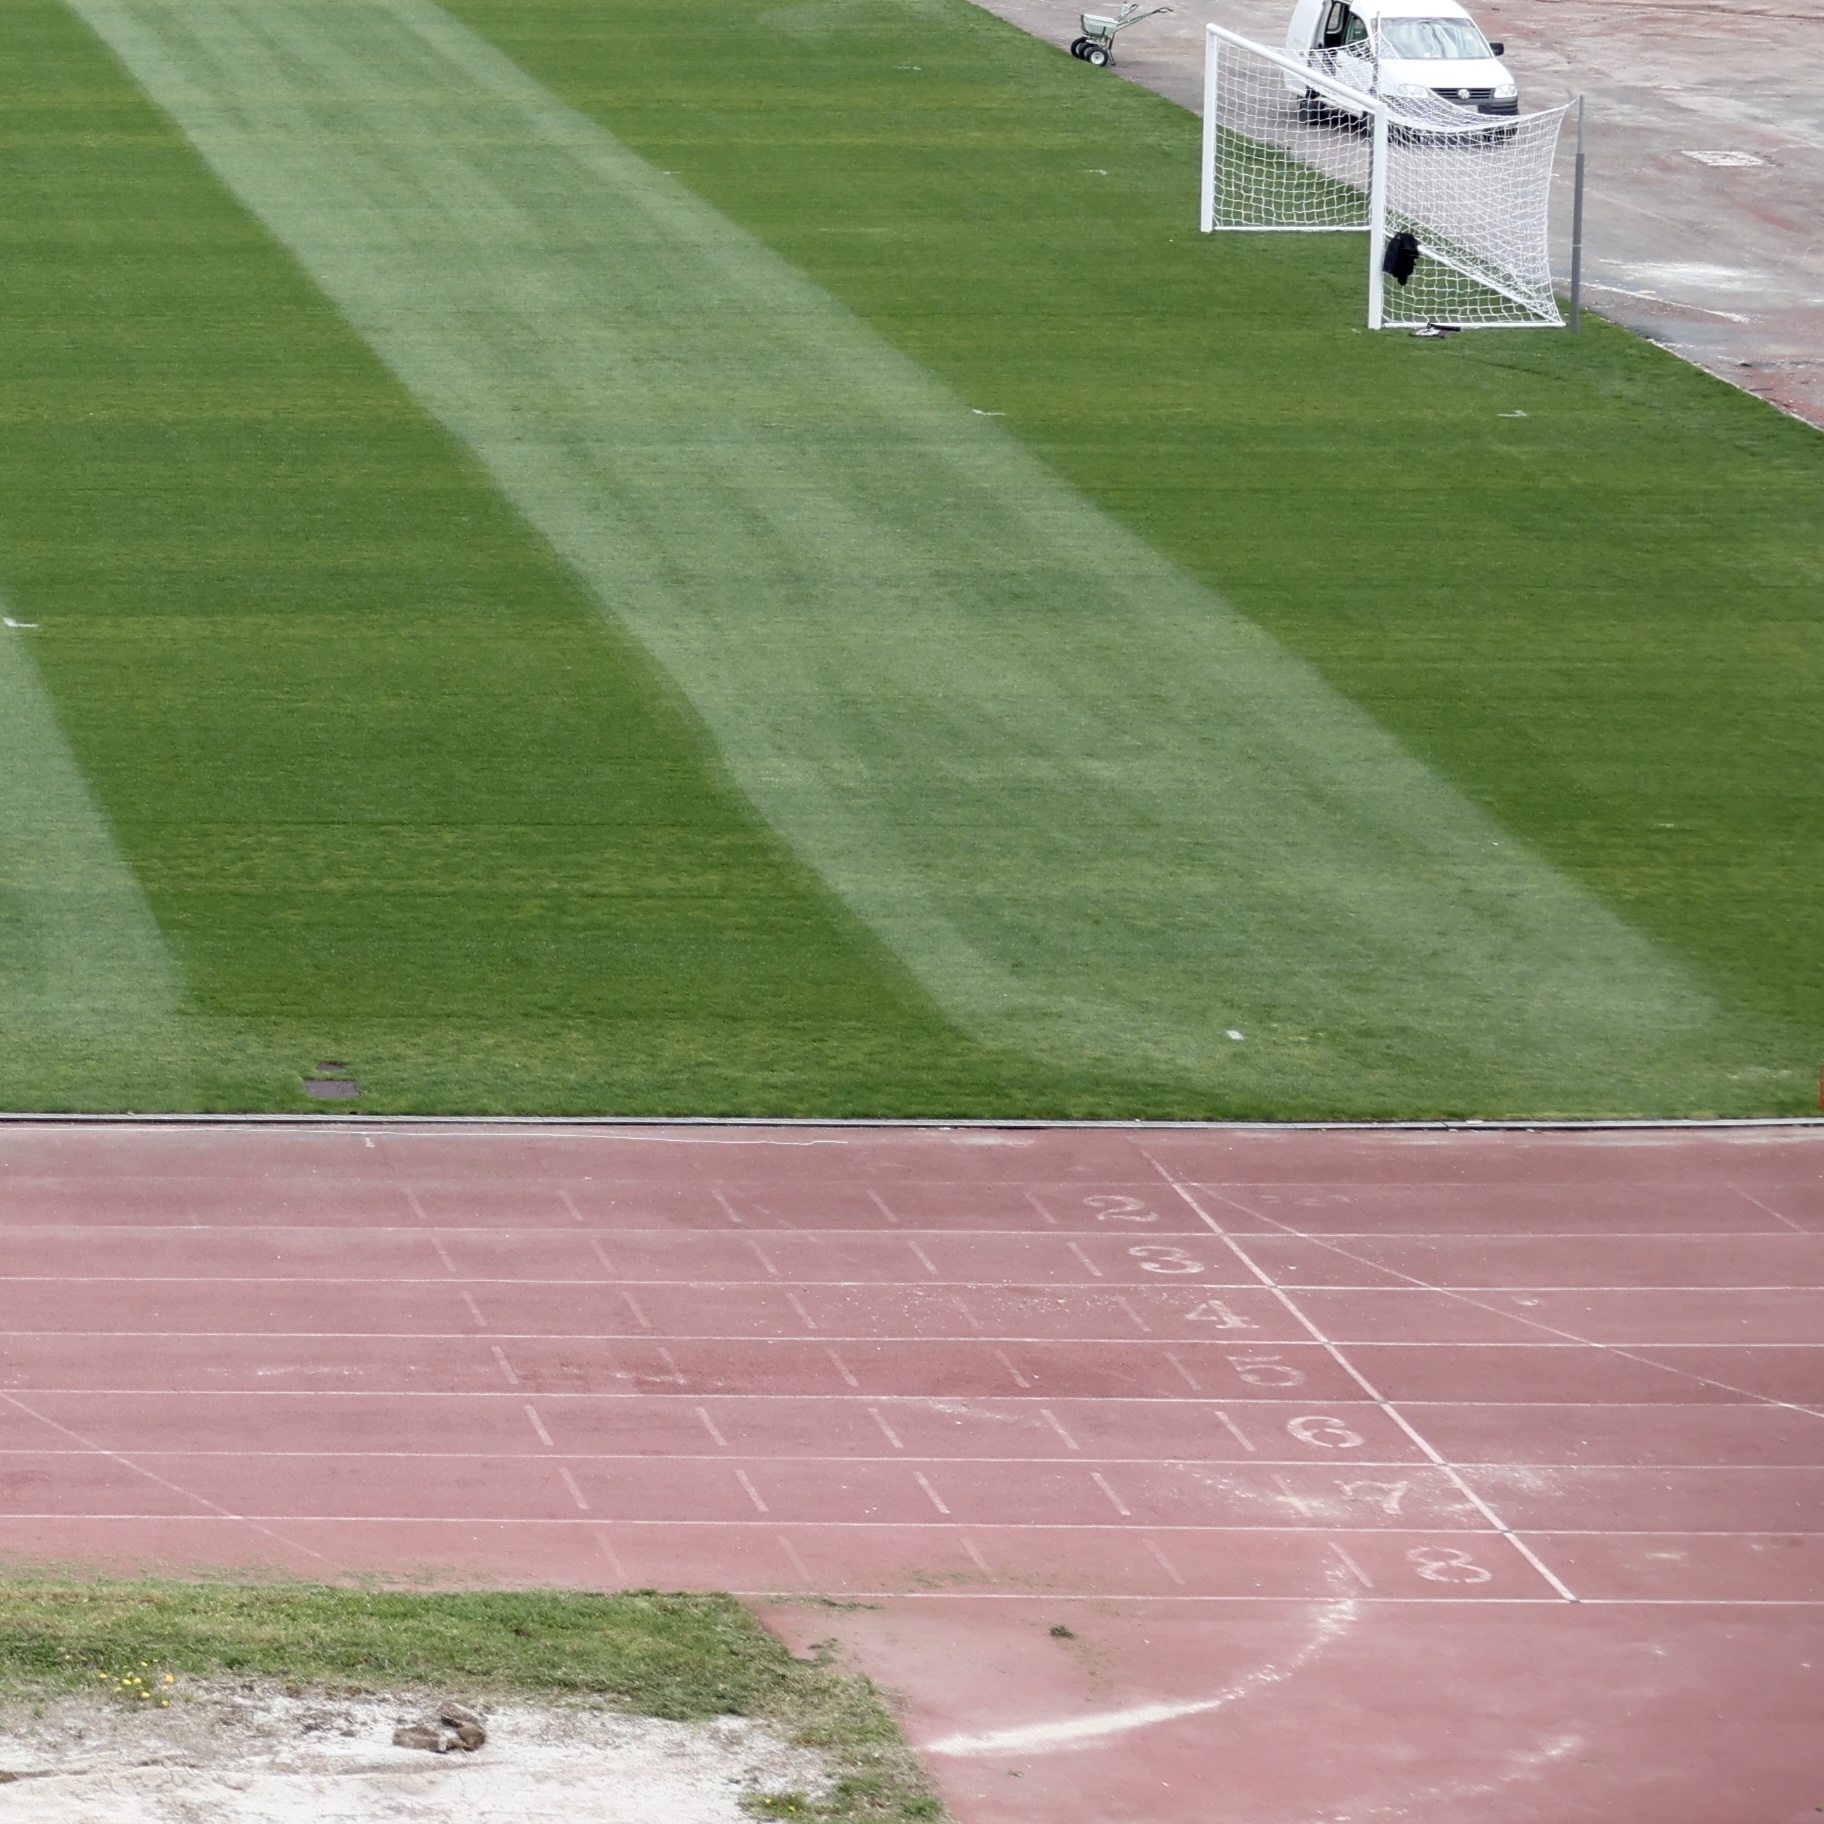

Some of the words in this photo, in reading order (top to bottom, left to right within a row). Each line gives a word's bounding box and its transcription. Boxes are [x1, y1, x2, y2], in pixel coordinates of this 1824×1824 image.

[1083, 1195, 1158, 1223] 2
[1128, 1245, 1205, 1275] 3
[1185, 1300, 1260, 1330] 4
[1226, 1355, 1305, 1387] 5
[1286, 1416, 1366, 1449] 6
[1335, 1480, 1409, 1515] 7
[1406, 1547, 1492, 1584] 8
